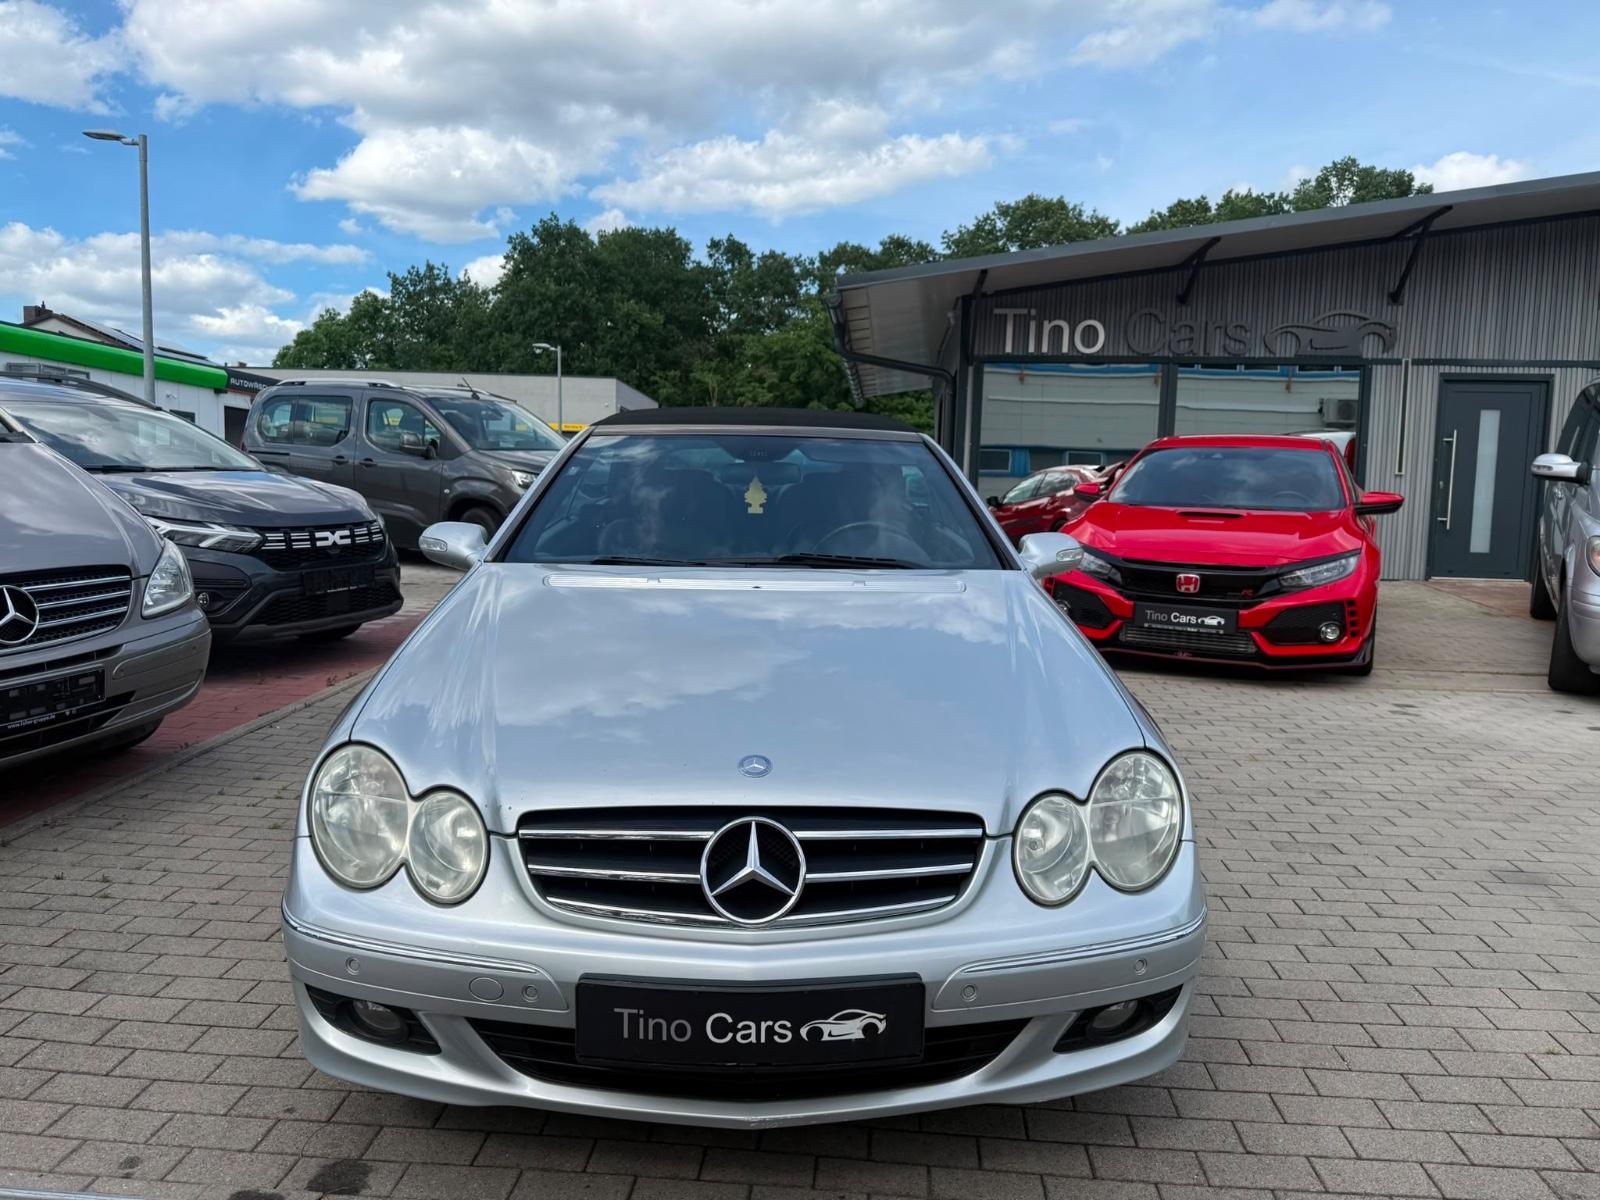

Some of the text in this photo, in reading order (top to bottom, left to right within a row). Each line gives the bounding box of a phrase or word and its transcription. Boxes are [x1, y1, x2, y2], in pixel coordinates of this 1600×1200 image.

[993, 307, 1250, 355] Tino Cars
[1145, 609, 1197, 624] Tino Cars
[613, 1007, 793, 1044] Tino Cars
